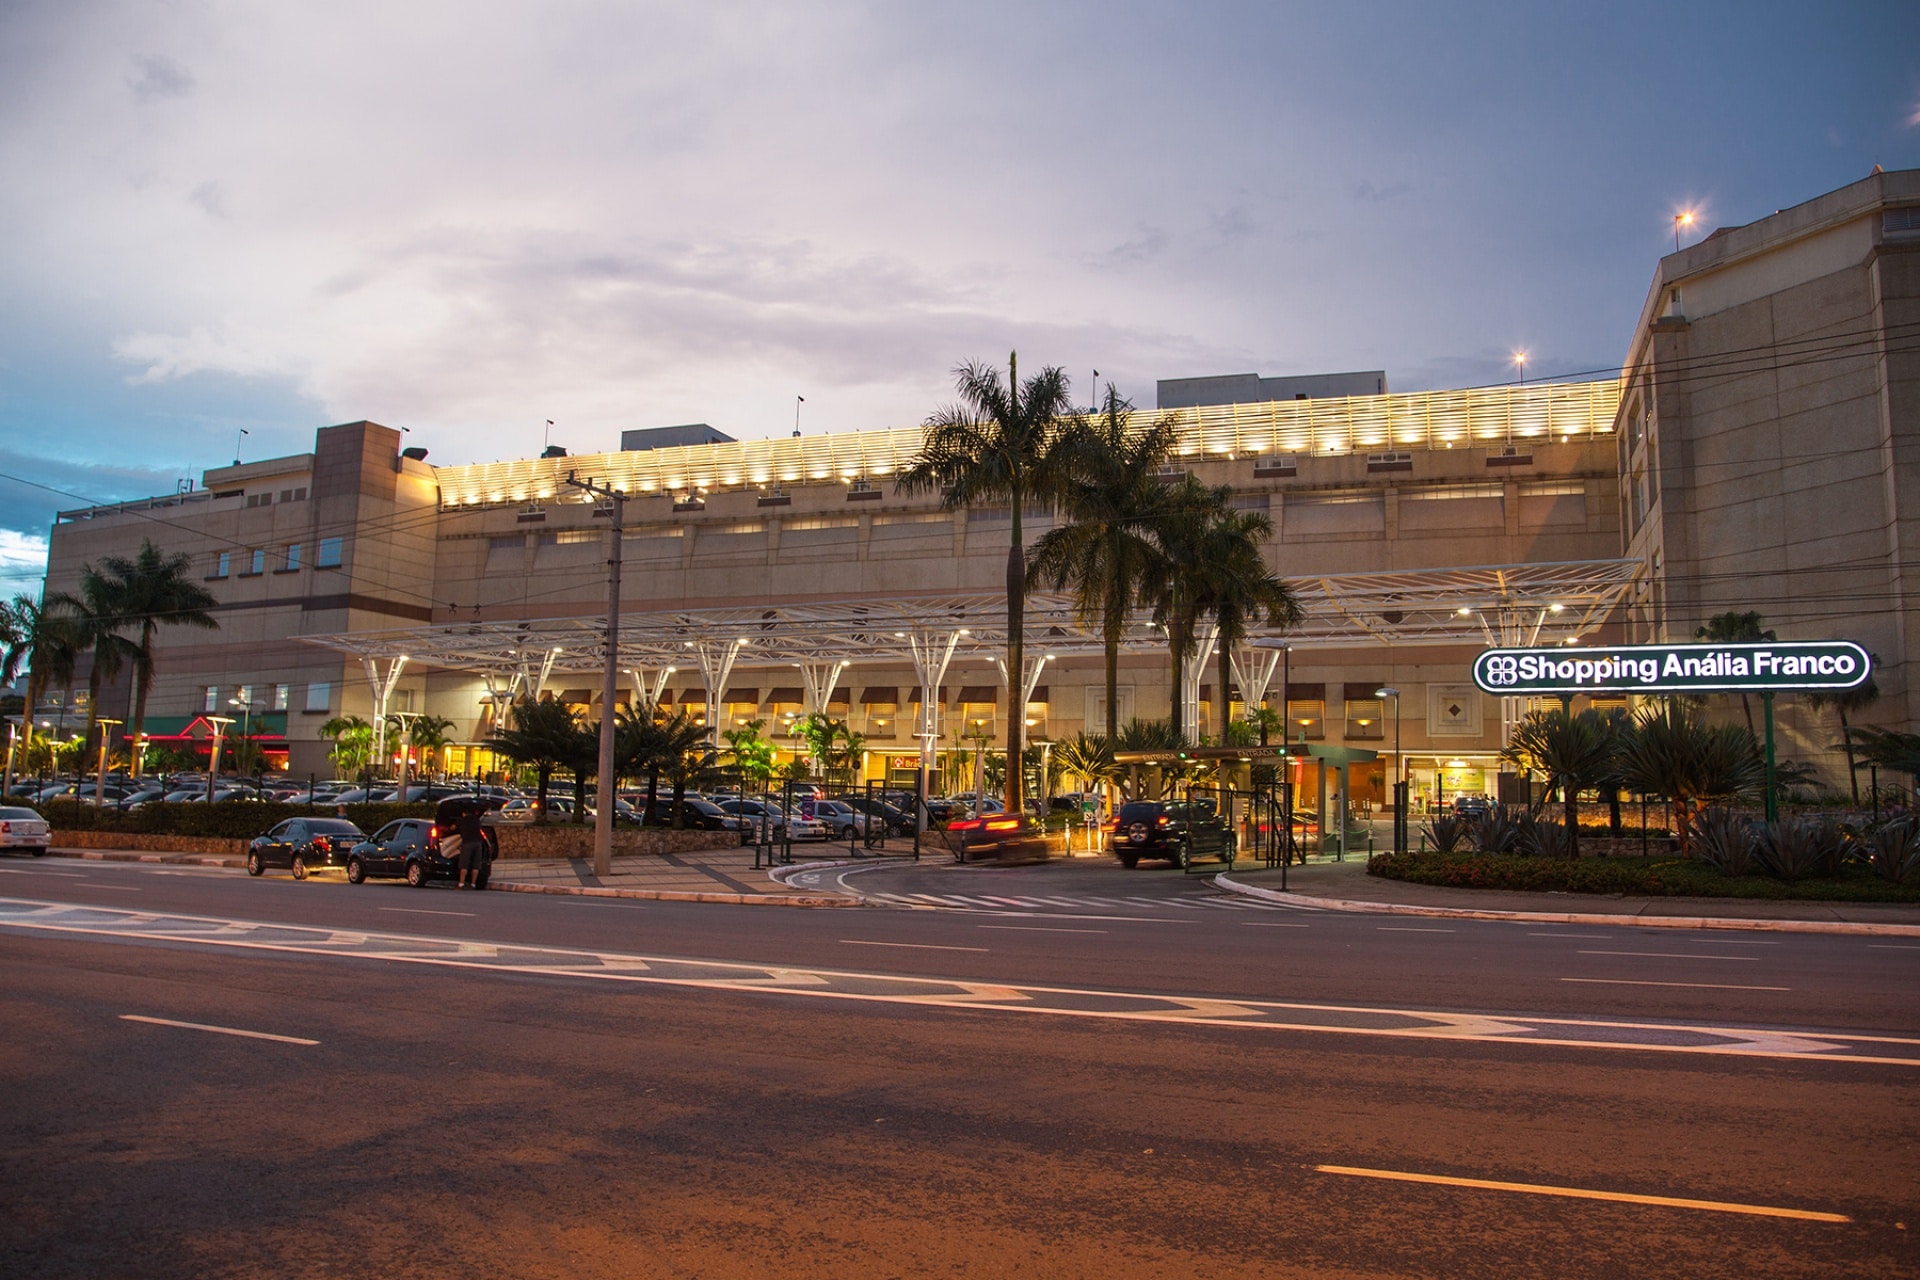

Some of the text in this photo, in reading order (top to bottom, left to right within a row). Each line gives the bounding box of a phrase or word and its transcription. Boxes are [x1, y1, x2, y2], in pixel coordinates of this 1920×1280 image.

[1518, 651, 1856, 683] Shopping Anália Franco
